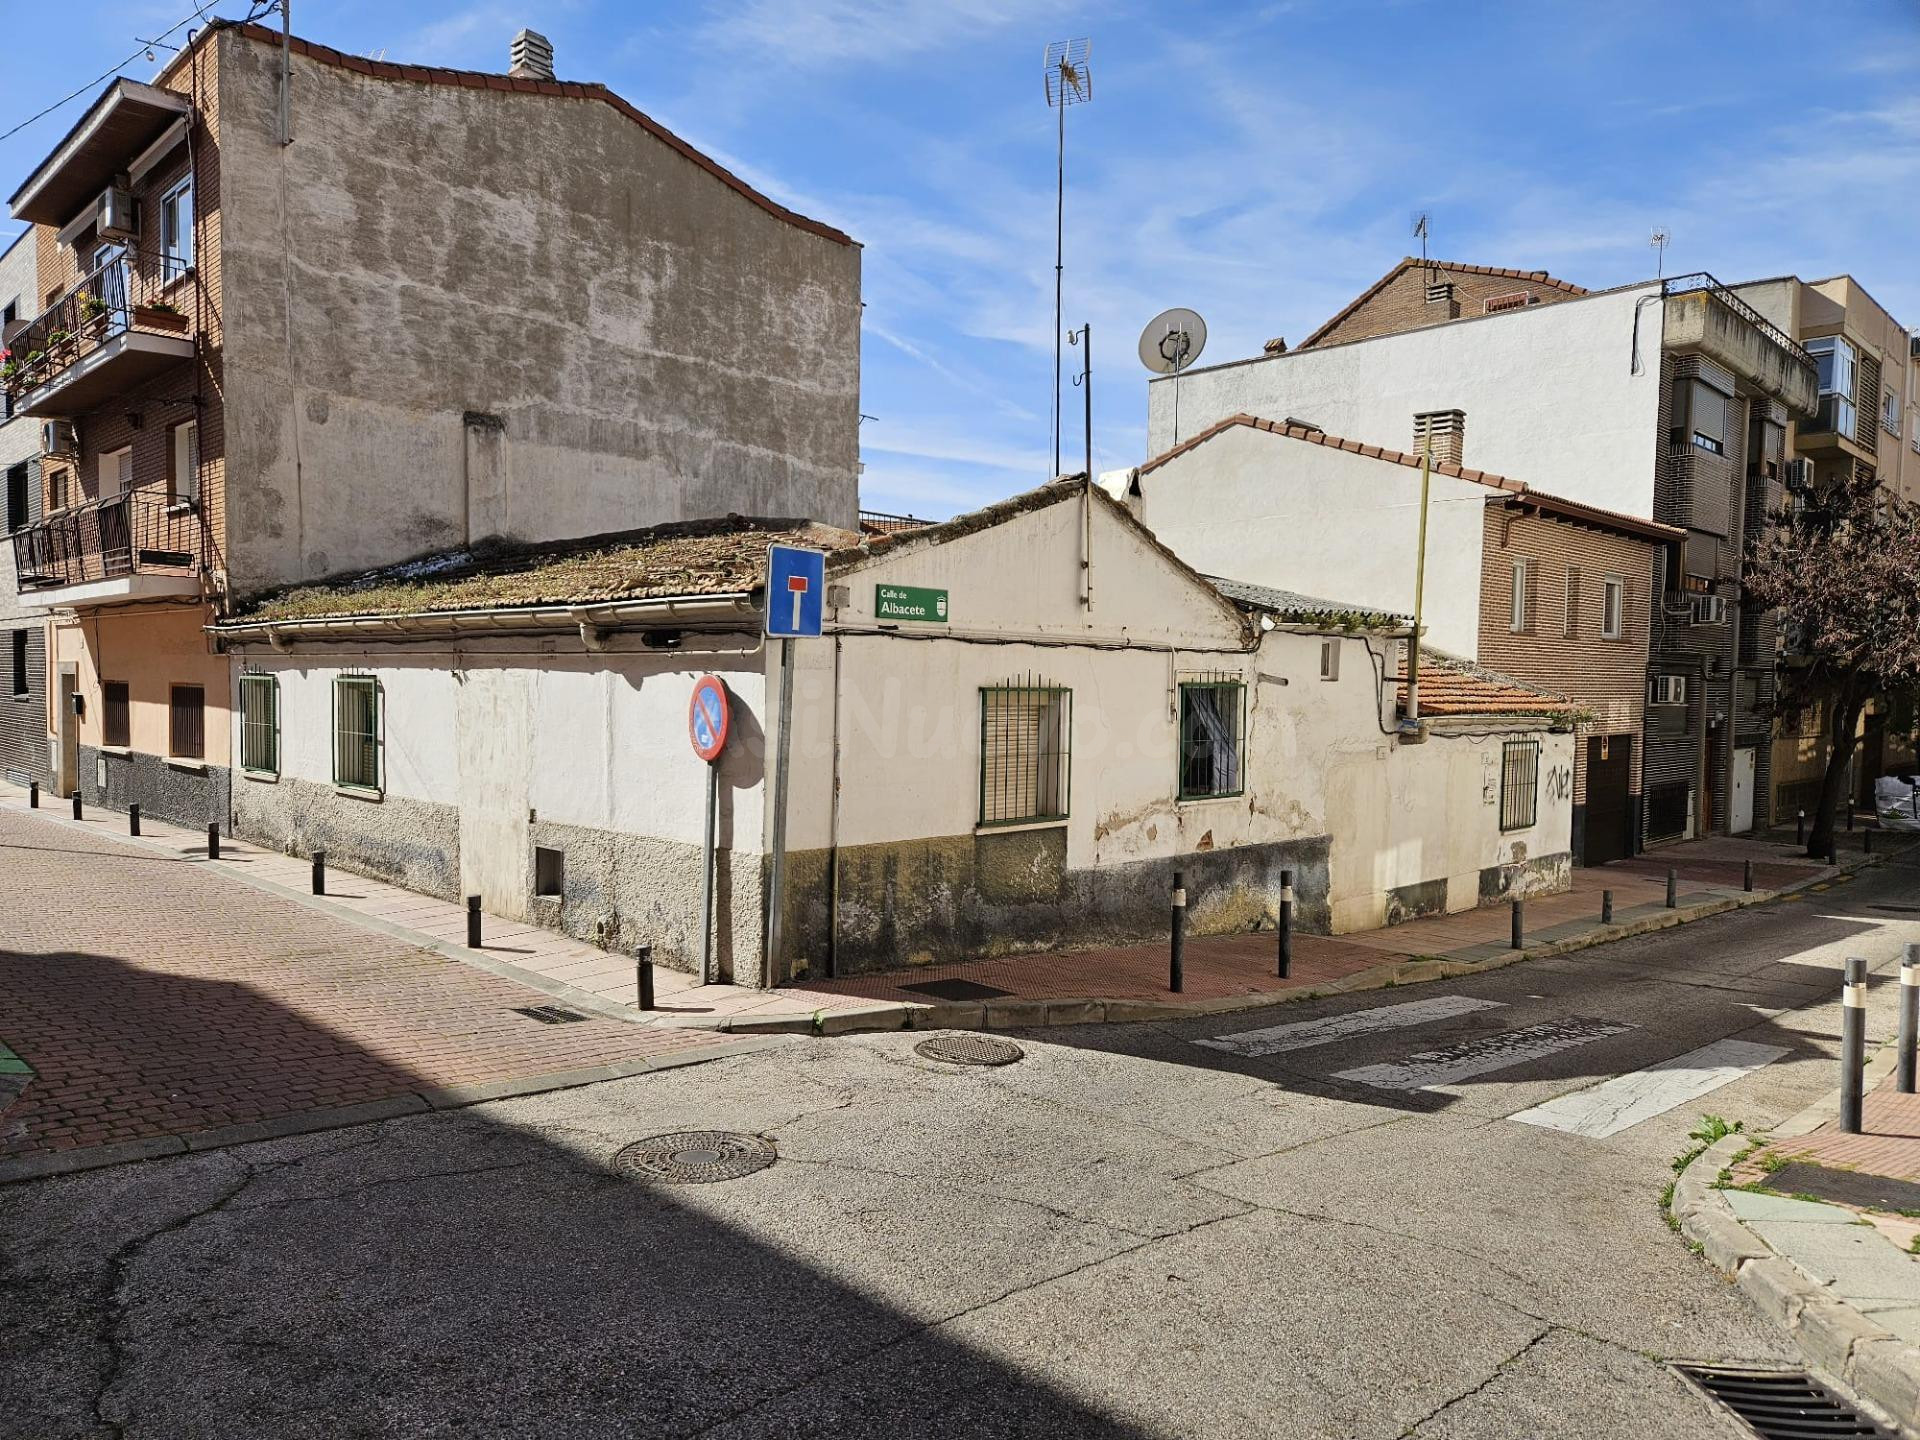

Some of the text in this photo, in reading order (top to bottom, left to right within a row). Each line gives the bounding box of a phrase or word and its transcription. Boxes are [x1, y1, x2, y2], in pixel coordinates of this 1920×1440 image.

[881, 589, 907, 599] Calle de
[881, 602, 925, 615] Albacete
